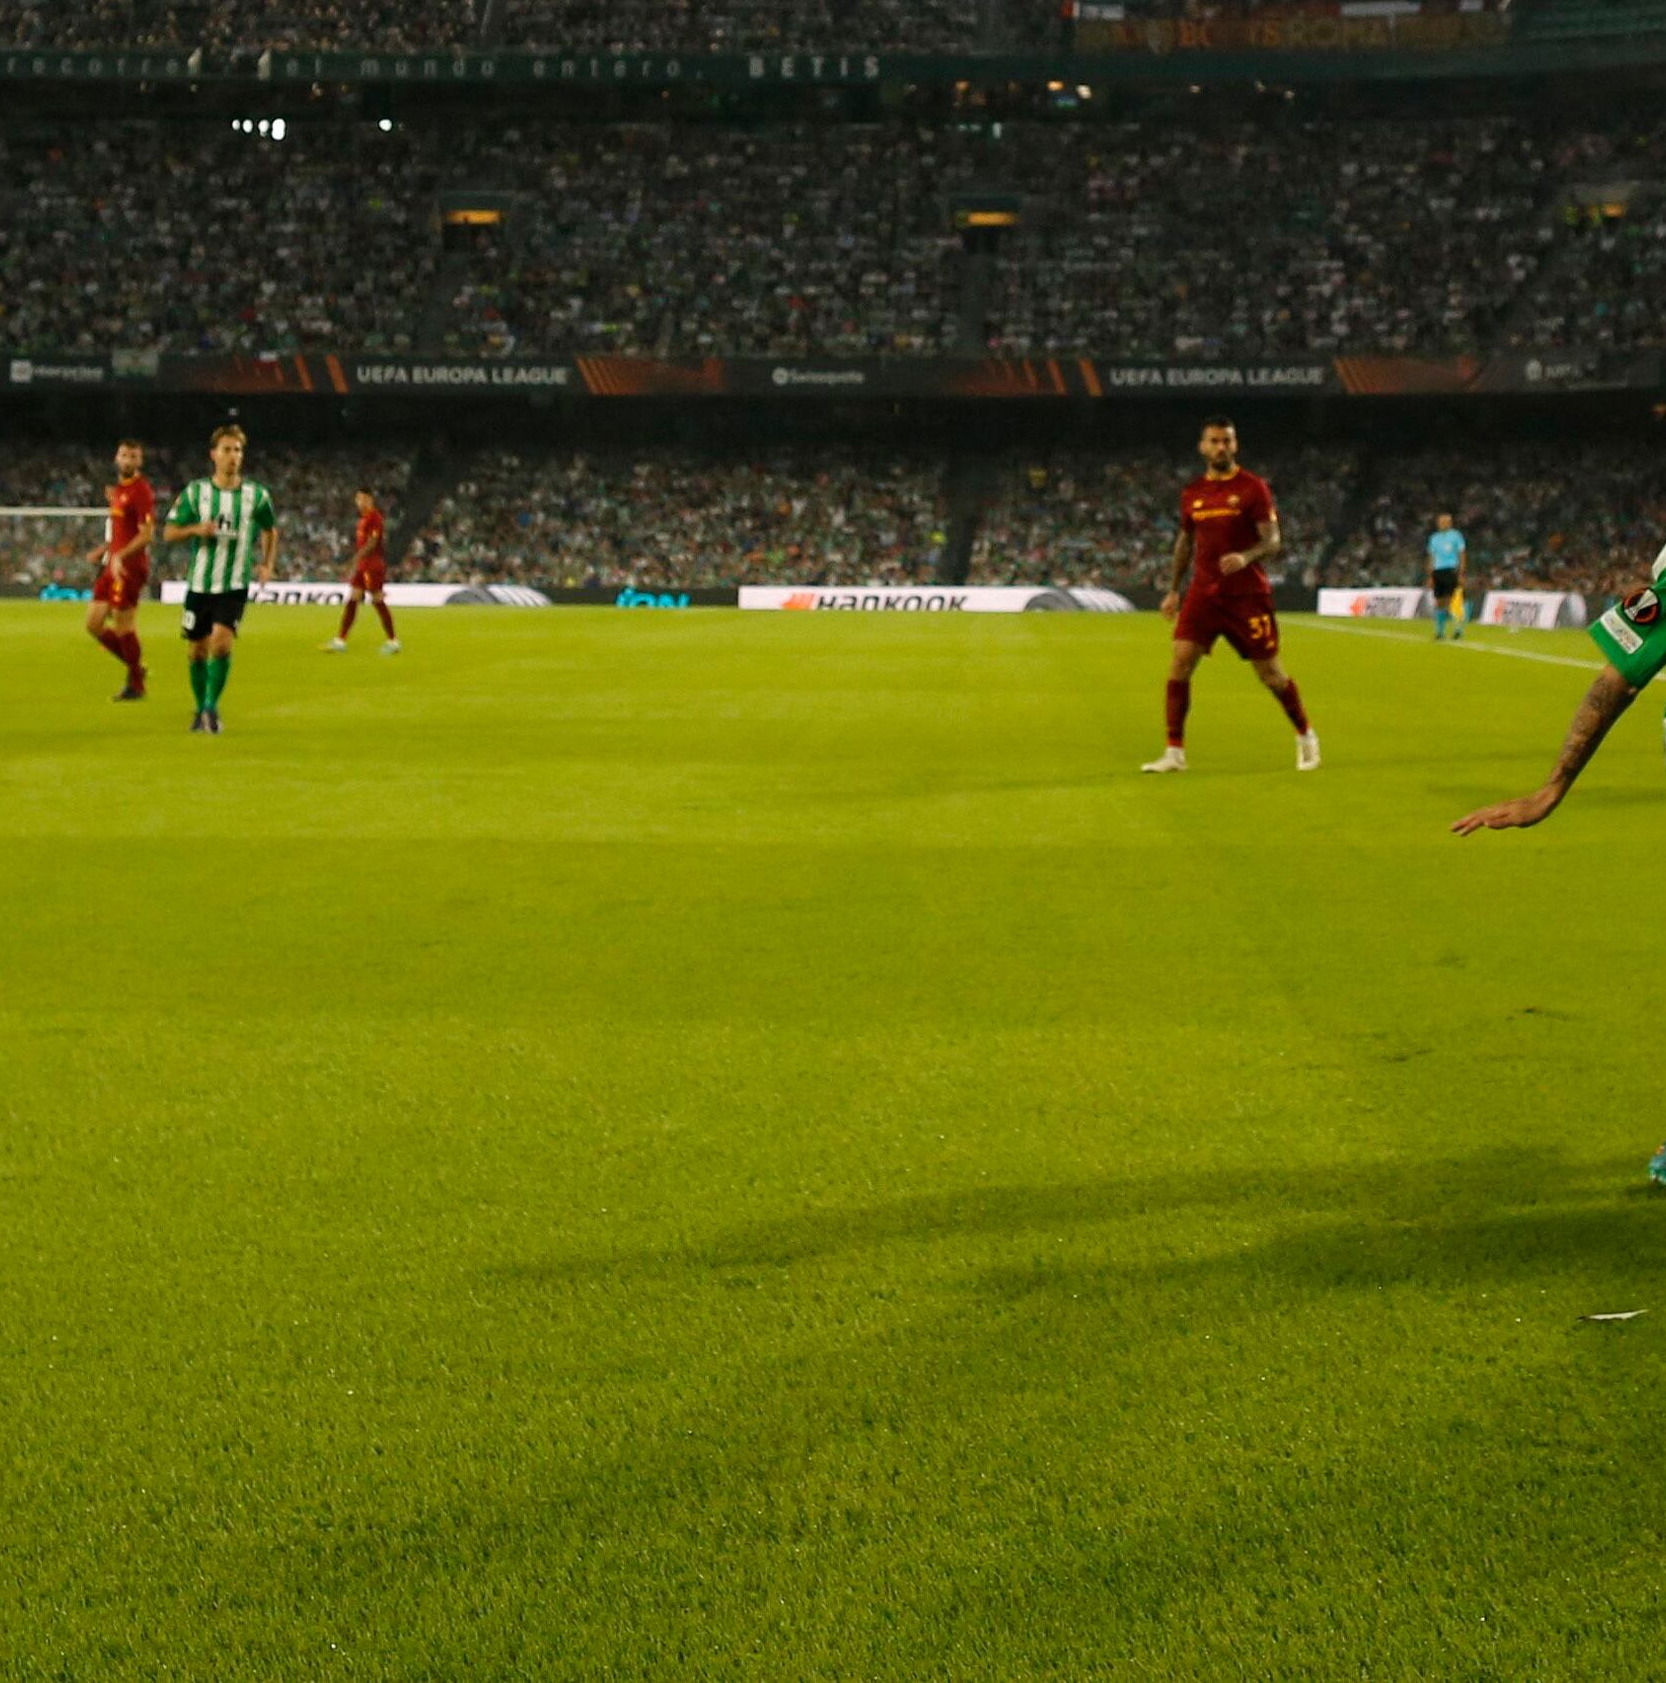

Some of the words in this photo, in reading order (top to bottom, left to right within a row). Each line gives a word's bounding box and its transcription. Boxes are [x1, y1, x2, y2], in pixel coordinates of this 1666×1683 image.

[359, 54, 496, 79] mundo
[747, 54, 880, 79] BETIS
[356, 365, 409, 384] UEFA
[411, 365, 488, 384] EUROPA
[491, 365, 570, 386] LEAGUE
[1109, 367, 1164, 386] UEFA
[1165, 367, 1244, 386] EUROPA
[1246, 366, 1326, 387] LEAGUE
